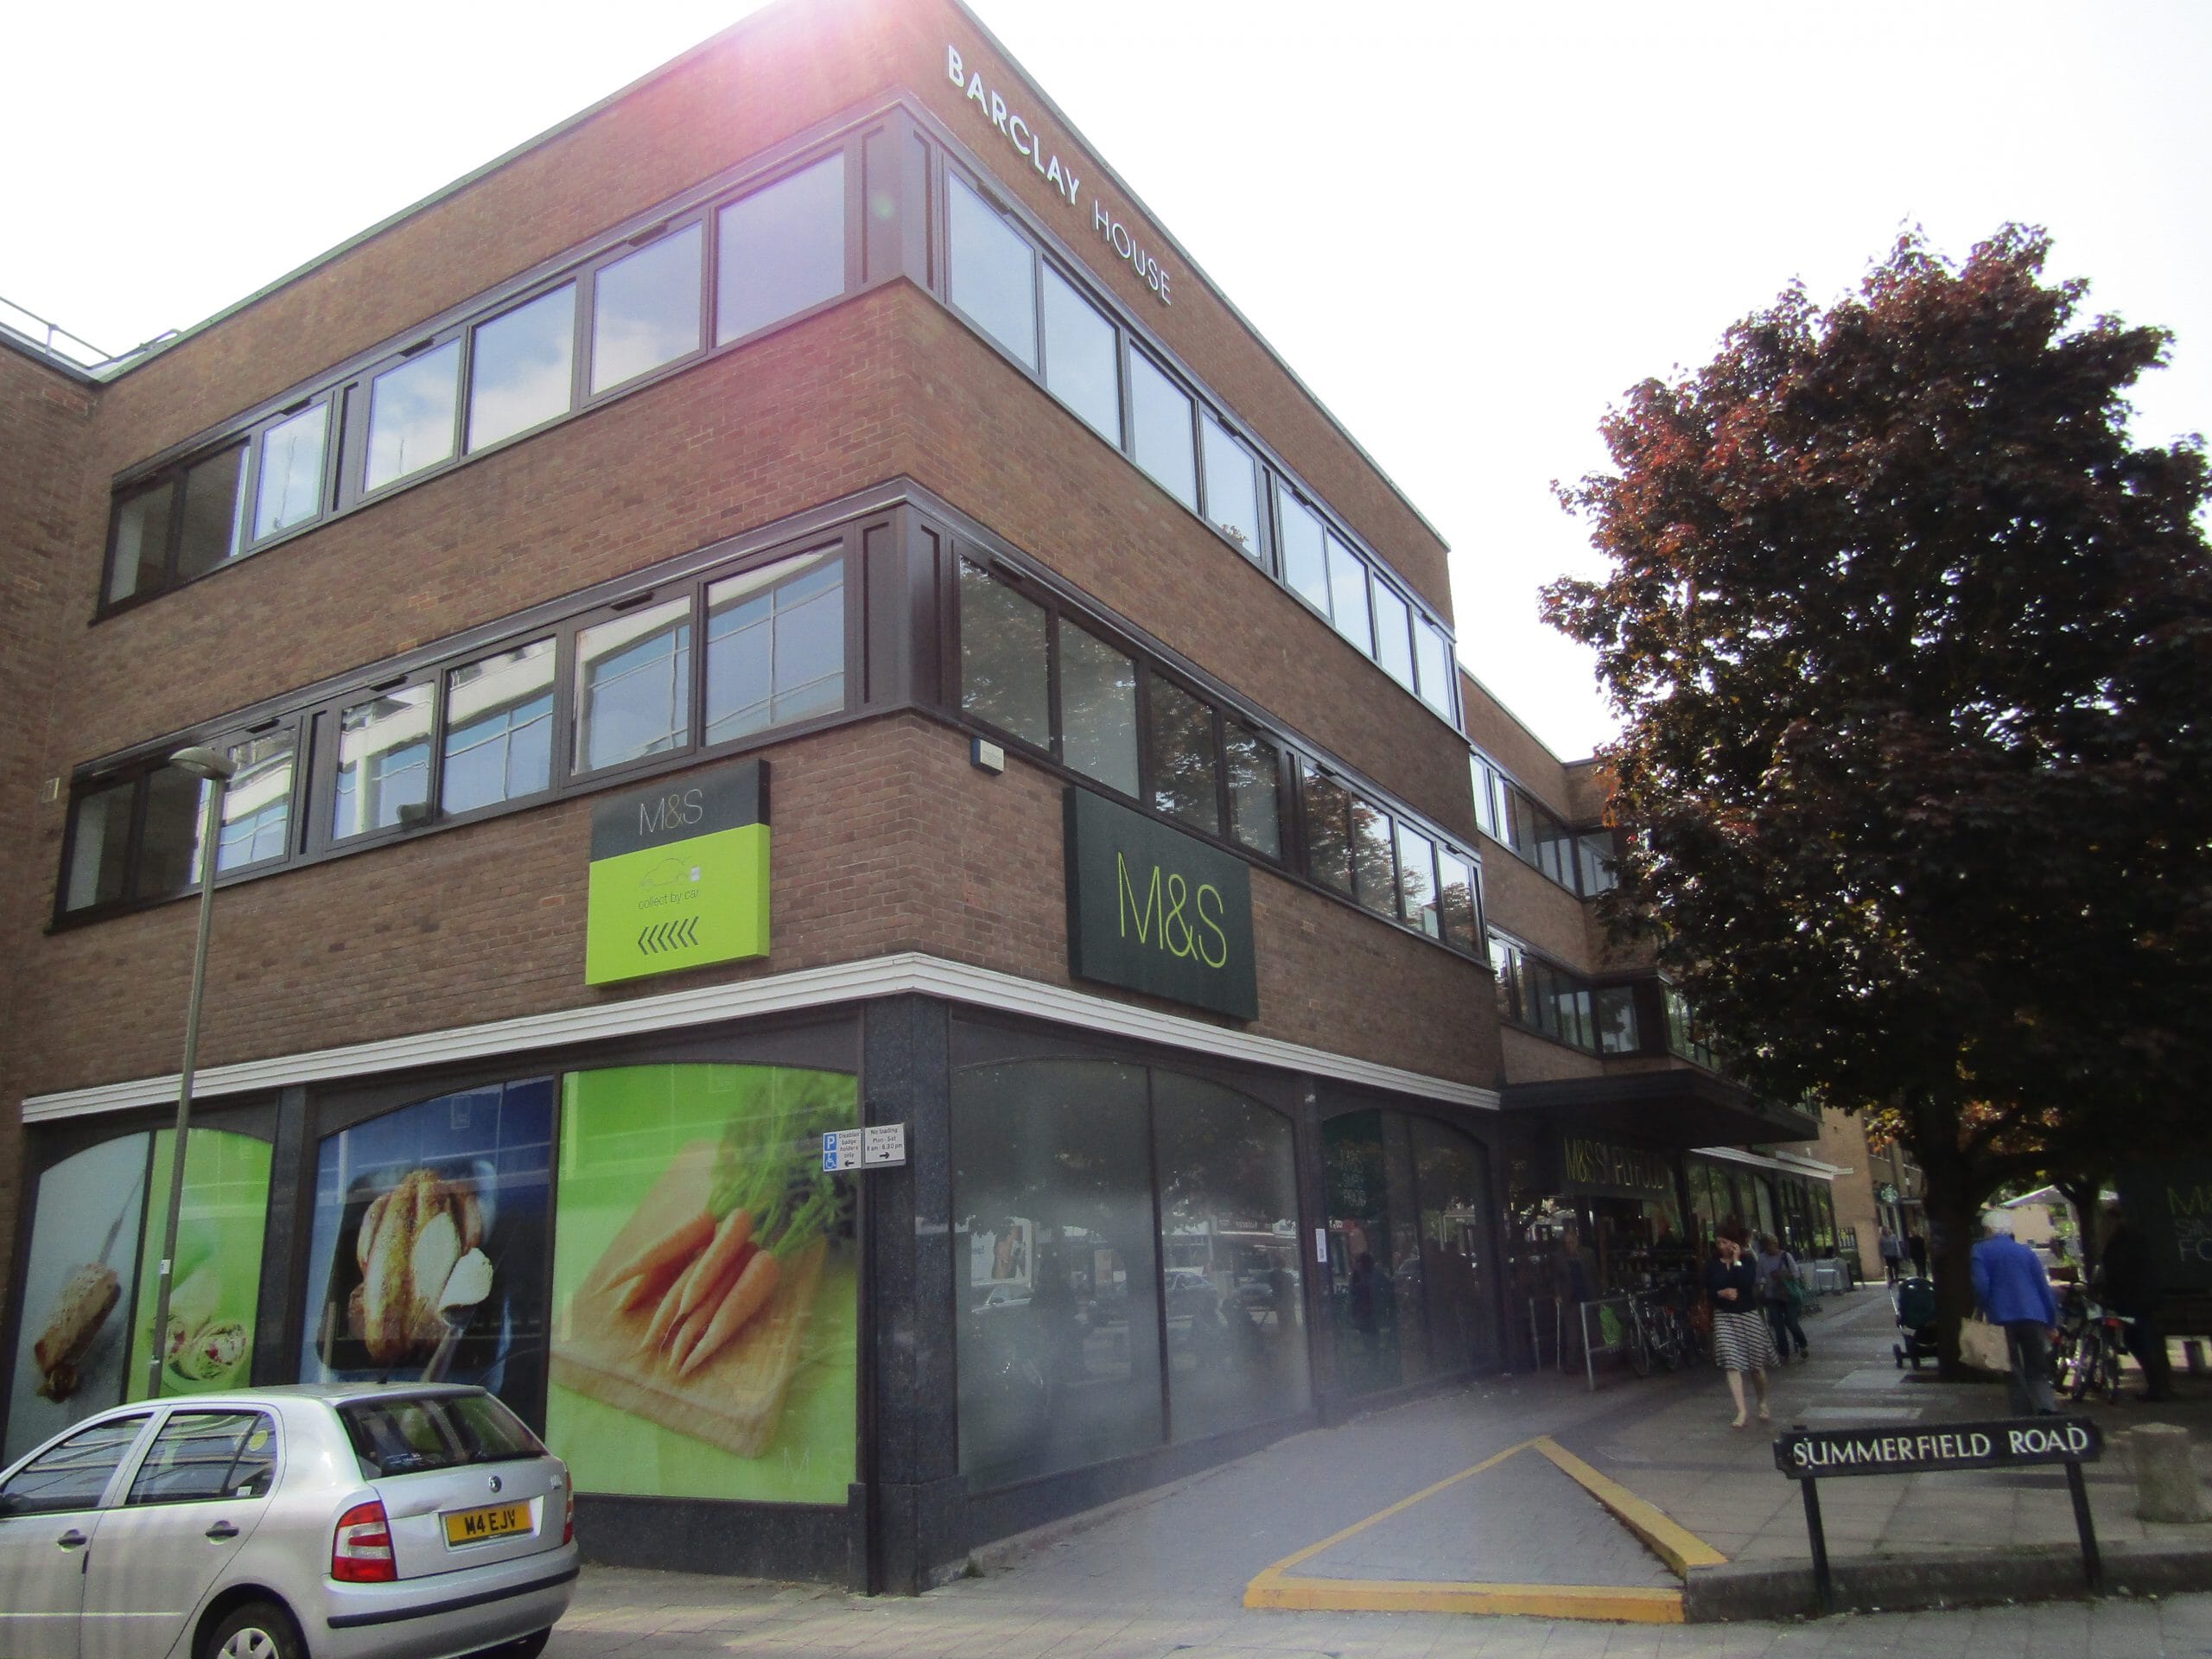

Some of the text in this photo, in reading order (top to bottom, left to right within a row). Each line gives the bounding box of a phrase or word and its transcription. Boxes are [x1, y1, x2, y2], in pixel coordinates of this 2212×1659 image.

[948, 45, 1171, 306] BARCLAY HOUSE
[639, 789, 703, 836] M&S
[638, 889, 699, 910] collect by car
[1118, 851, 1227, 969] M&S
[827, 1135, 835, 1149] P
[1793, 1425, 2088, 1466] SUMMERFIELD ROAD
[464, 1515, 486, 1535] M4
